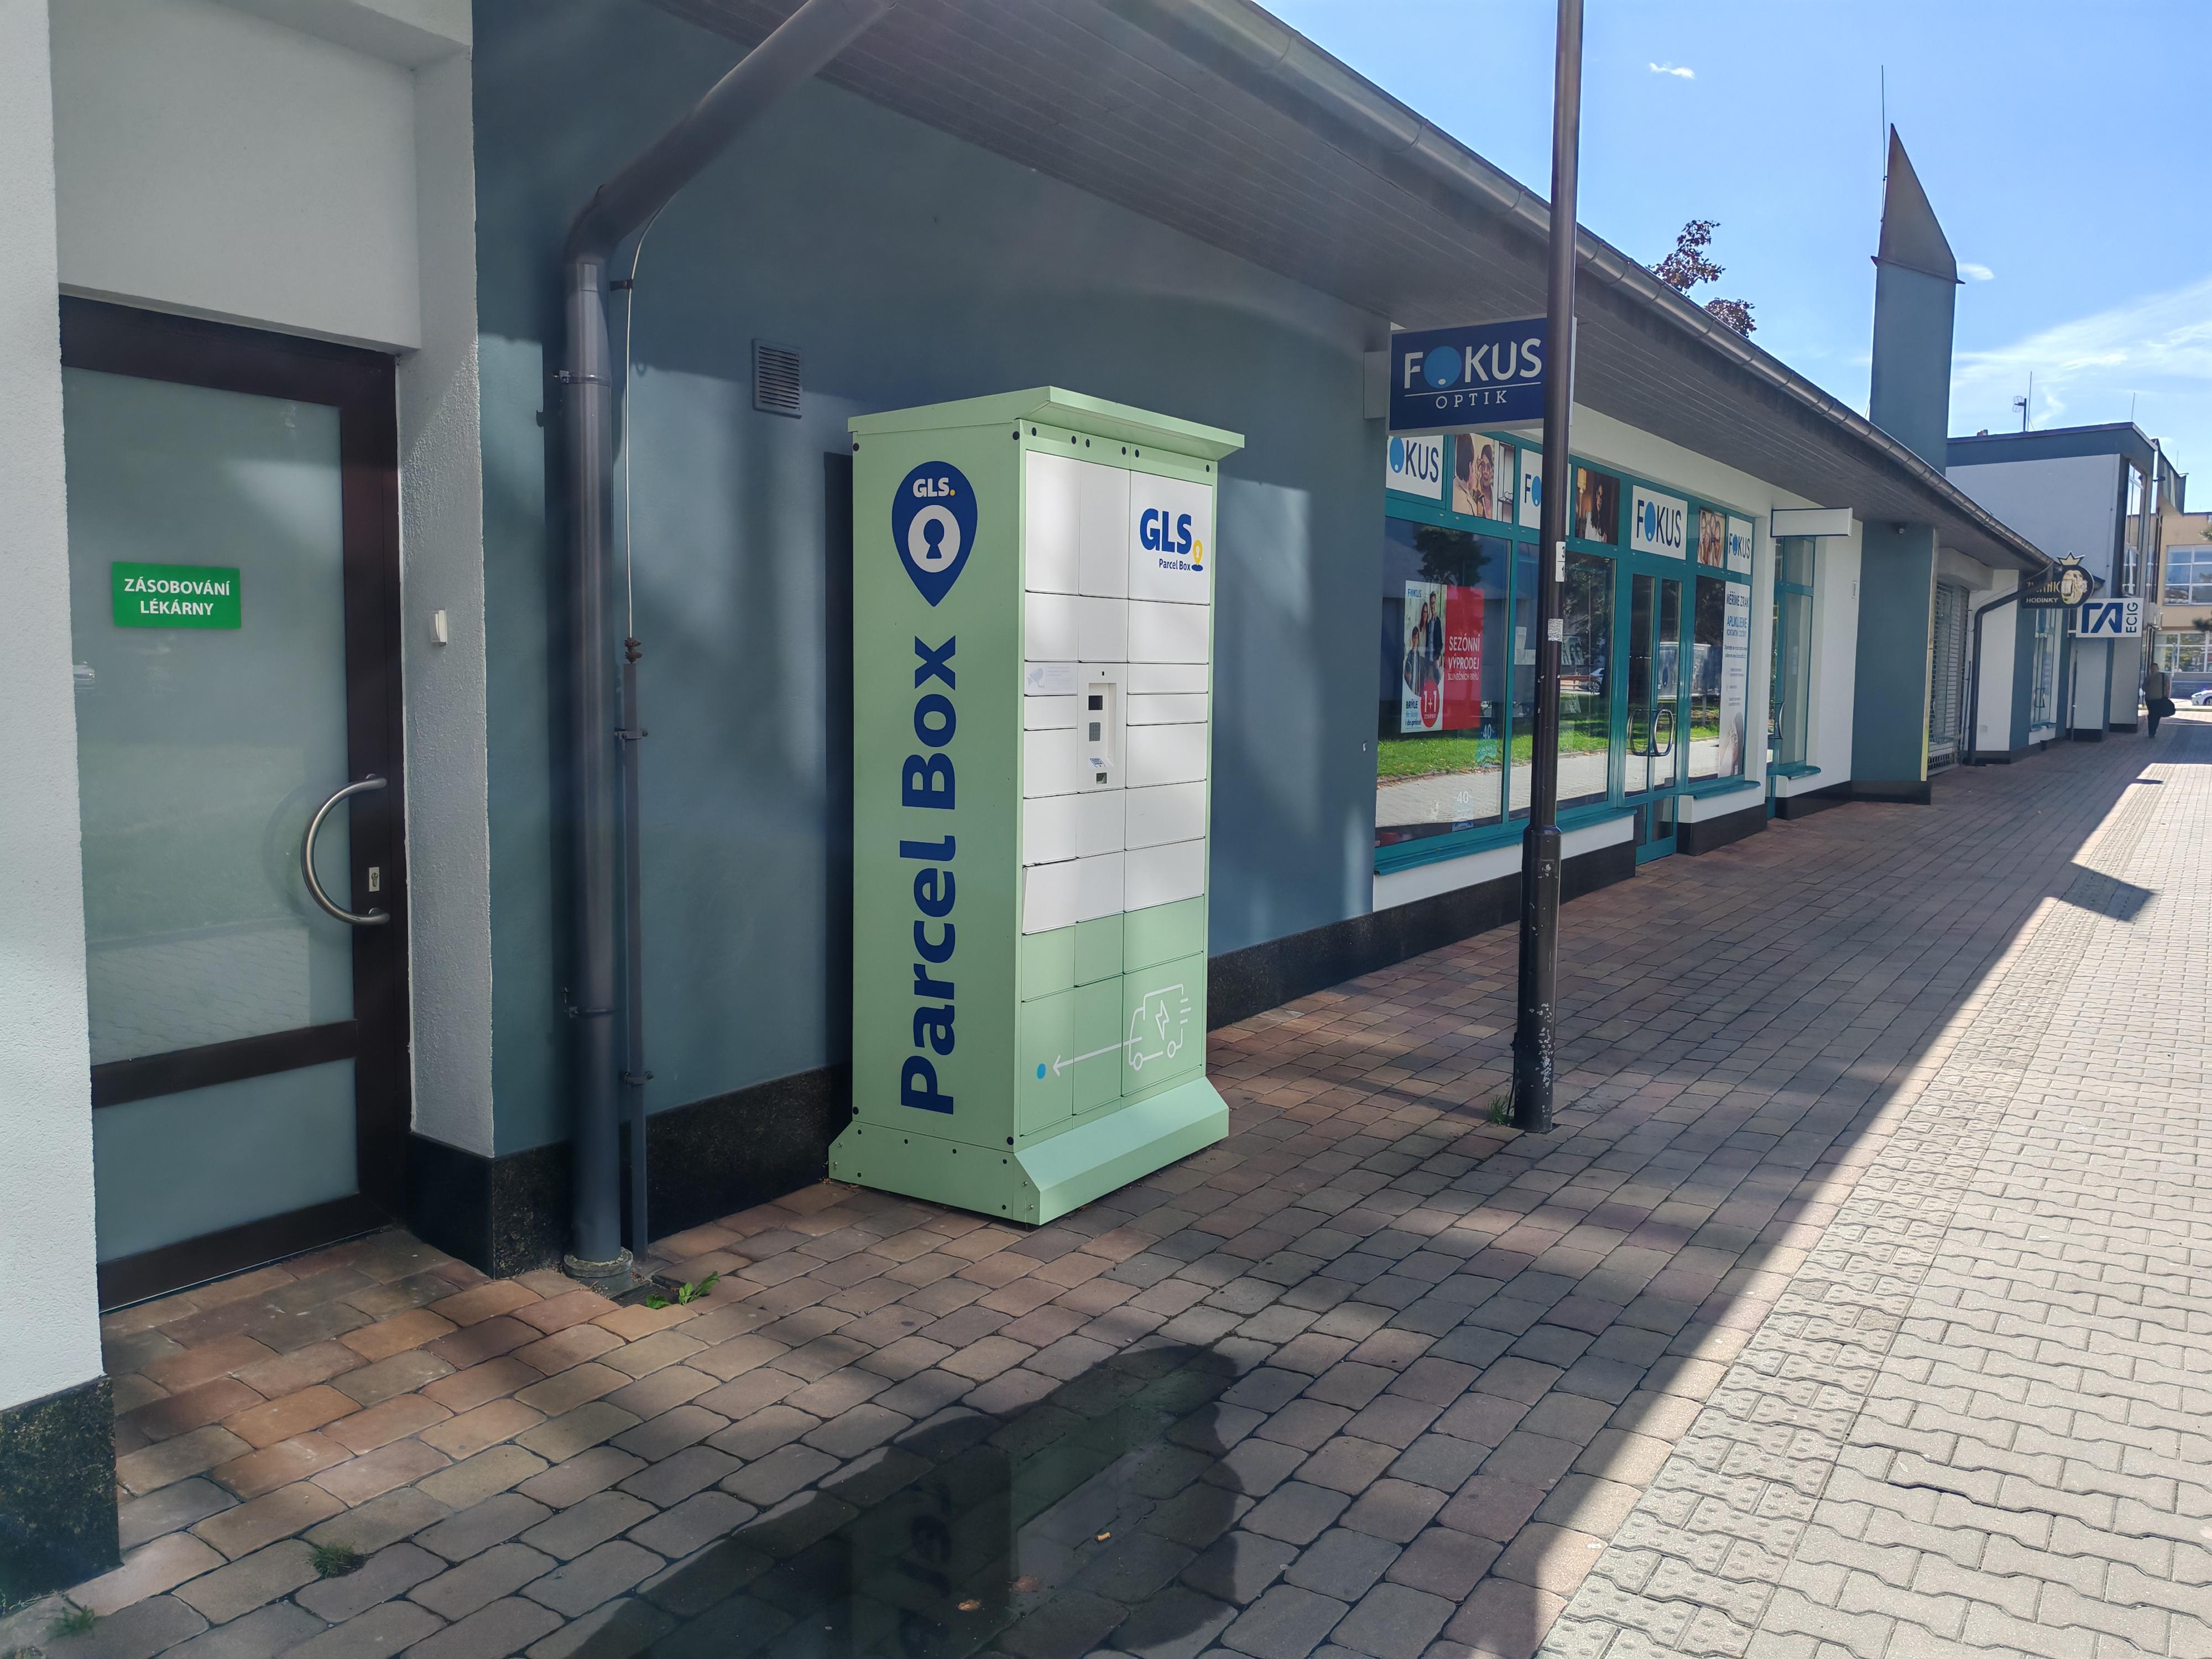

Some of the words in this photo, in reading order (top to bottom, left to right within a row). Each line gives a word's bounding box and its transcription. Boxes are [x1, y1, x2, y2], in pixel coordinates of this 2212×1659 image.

[1404, 338, 1542, 389] FOKUS
[1436, 390, 1507, 409] OPTIK
[1389, 436, 1439, 483] OKUS
[1140, 508, 1192, 555] GLS
[1636, 499, 1682, 549] FOKUS
[1728, 533, 1751, 559] FOKUS
[1159, 559, 1178, 570] Parcel
[1179, 561, 1191, 571] Box
[124, 576, 231, 596] ZÁSOBOVÁNÍ
[140, 598, 214, 615] LÉKÁRNY
[2126, 602, 2138, 633] ECIG
[1449, 633, 1480, 651] SEZÓNNÍ
[1448, 653, 1480, 670] VÝPRODEJ
[1423, 691, 1437, 713] 1+1
[901, 635, 957, 810] Box
[900, 834, 956, 1115] Parcel
